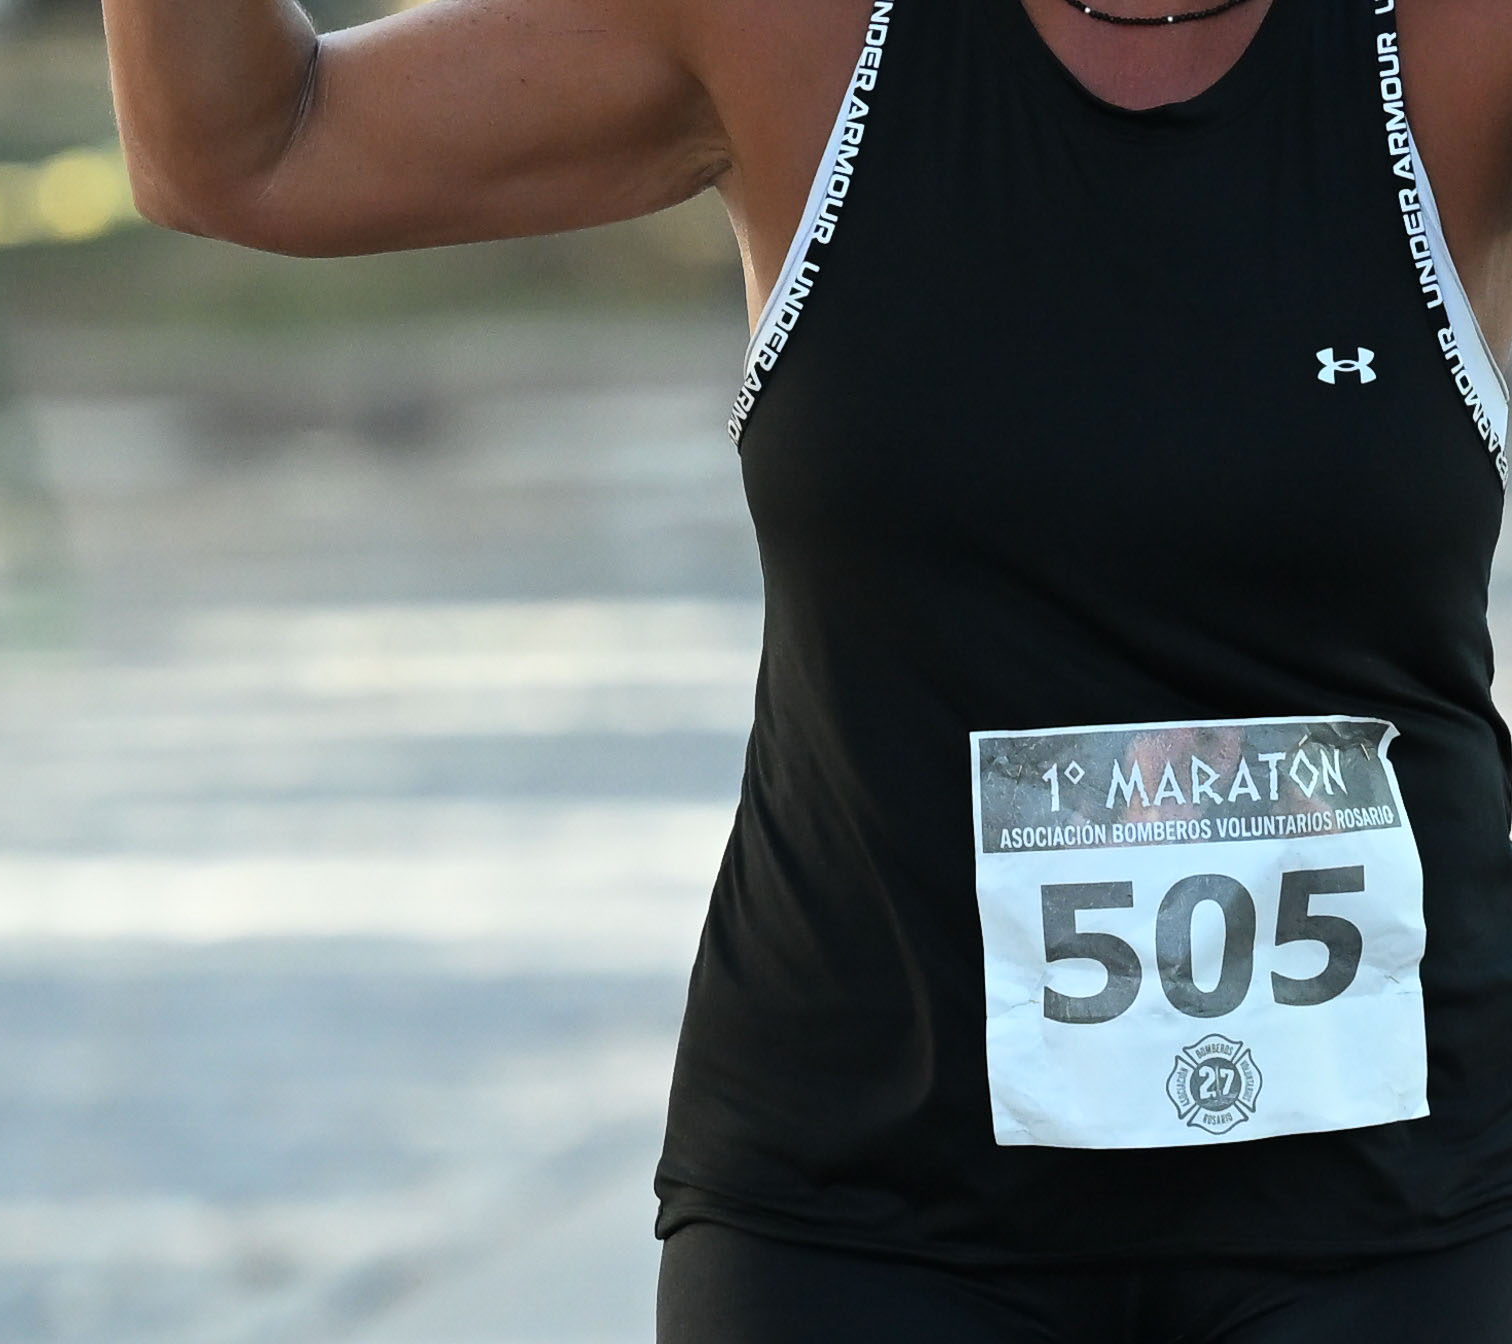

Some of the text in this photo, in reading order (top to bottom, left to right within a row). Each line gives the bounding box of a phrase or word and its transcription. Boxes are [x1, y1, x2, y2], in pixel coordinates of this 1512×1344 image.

[1377, 32, 1416, 182] ARMOUR
[811, 93, 871, 246] ARMOUR
[1398, 188, 1444, 309] UNDER
[753, 261, 820, 372] UNDER
[727, 363, 762, 446] ARMO
[1437, 326, 1500, 453] ARMOUR
[999, 805, 1395, 850] ASOCIACIÓN BOMBEROS VOLUNTARIOS ROSARIO
[1105, 734, 1348, 810] MARATÓN
[1040, 864, 1366, 1026] 505
[1198, 1065, 1235, 1100] 27
